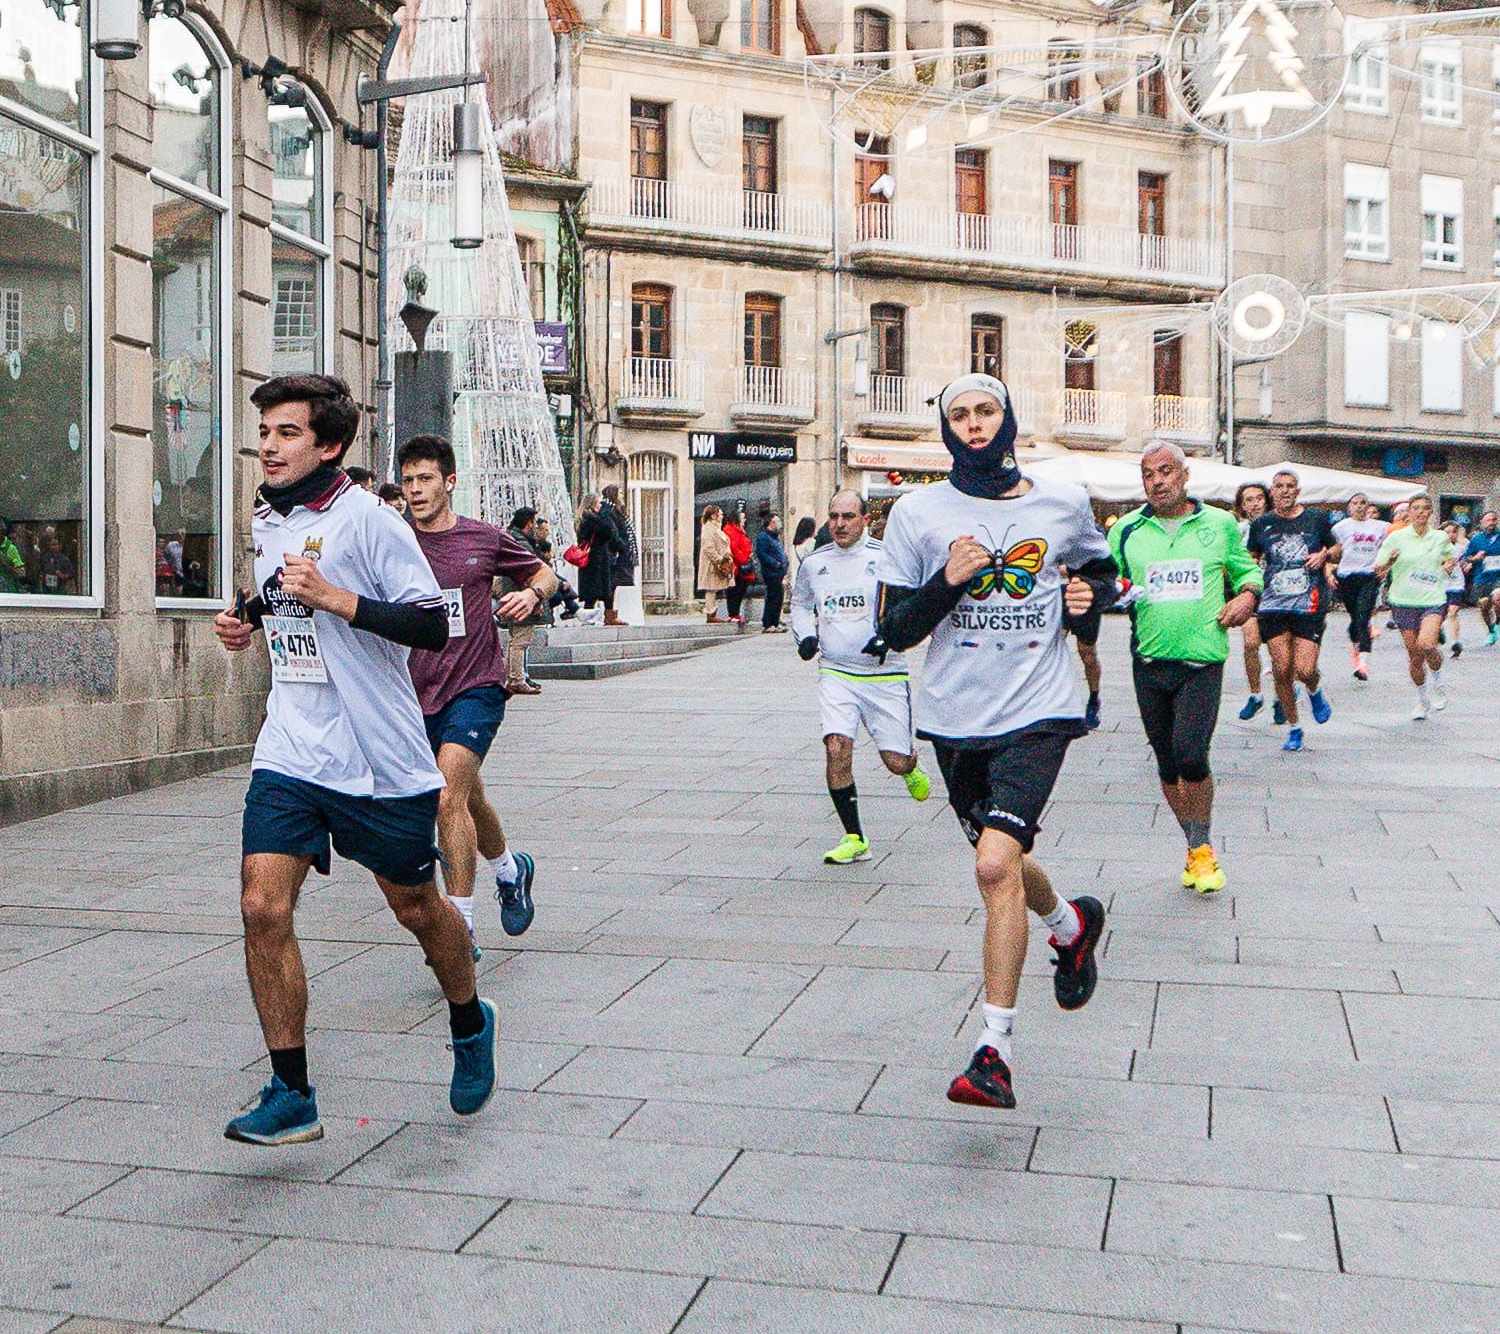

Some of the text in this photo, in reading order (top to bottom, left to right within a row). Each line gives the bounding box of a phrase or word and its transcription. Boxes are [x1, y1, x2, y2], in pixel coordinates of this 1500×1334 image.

[760, 445, 794, 459] Nogueira
[1167, 570, 1199, 584] 4075
[273, 601, 307, 617] Galicia
[838, 595, 865, 608] 4753
[951, 612, 1047, 631] SILVESTRE
[287, 634, 317, 657] 4719
